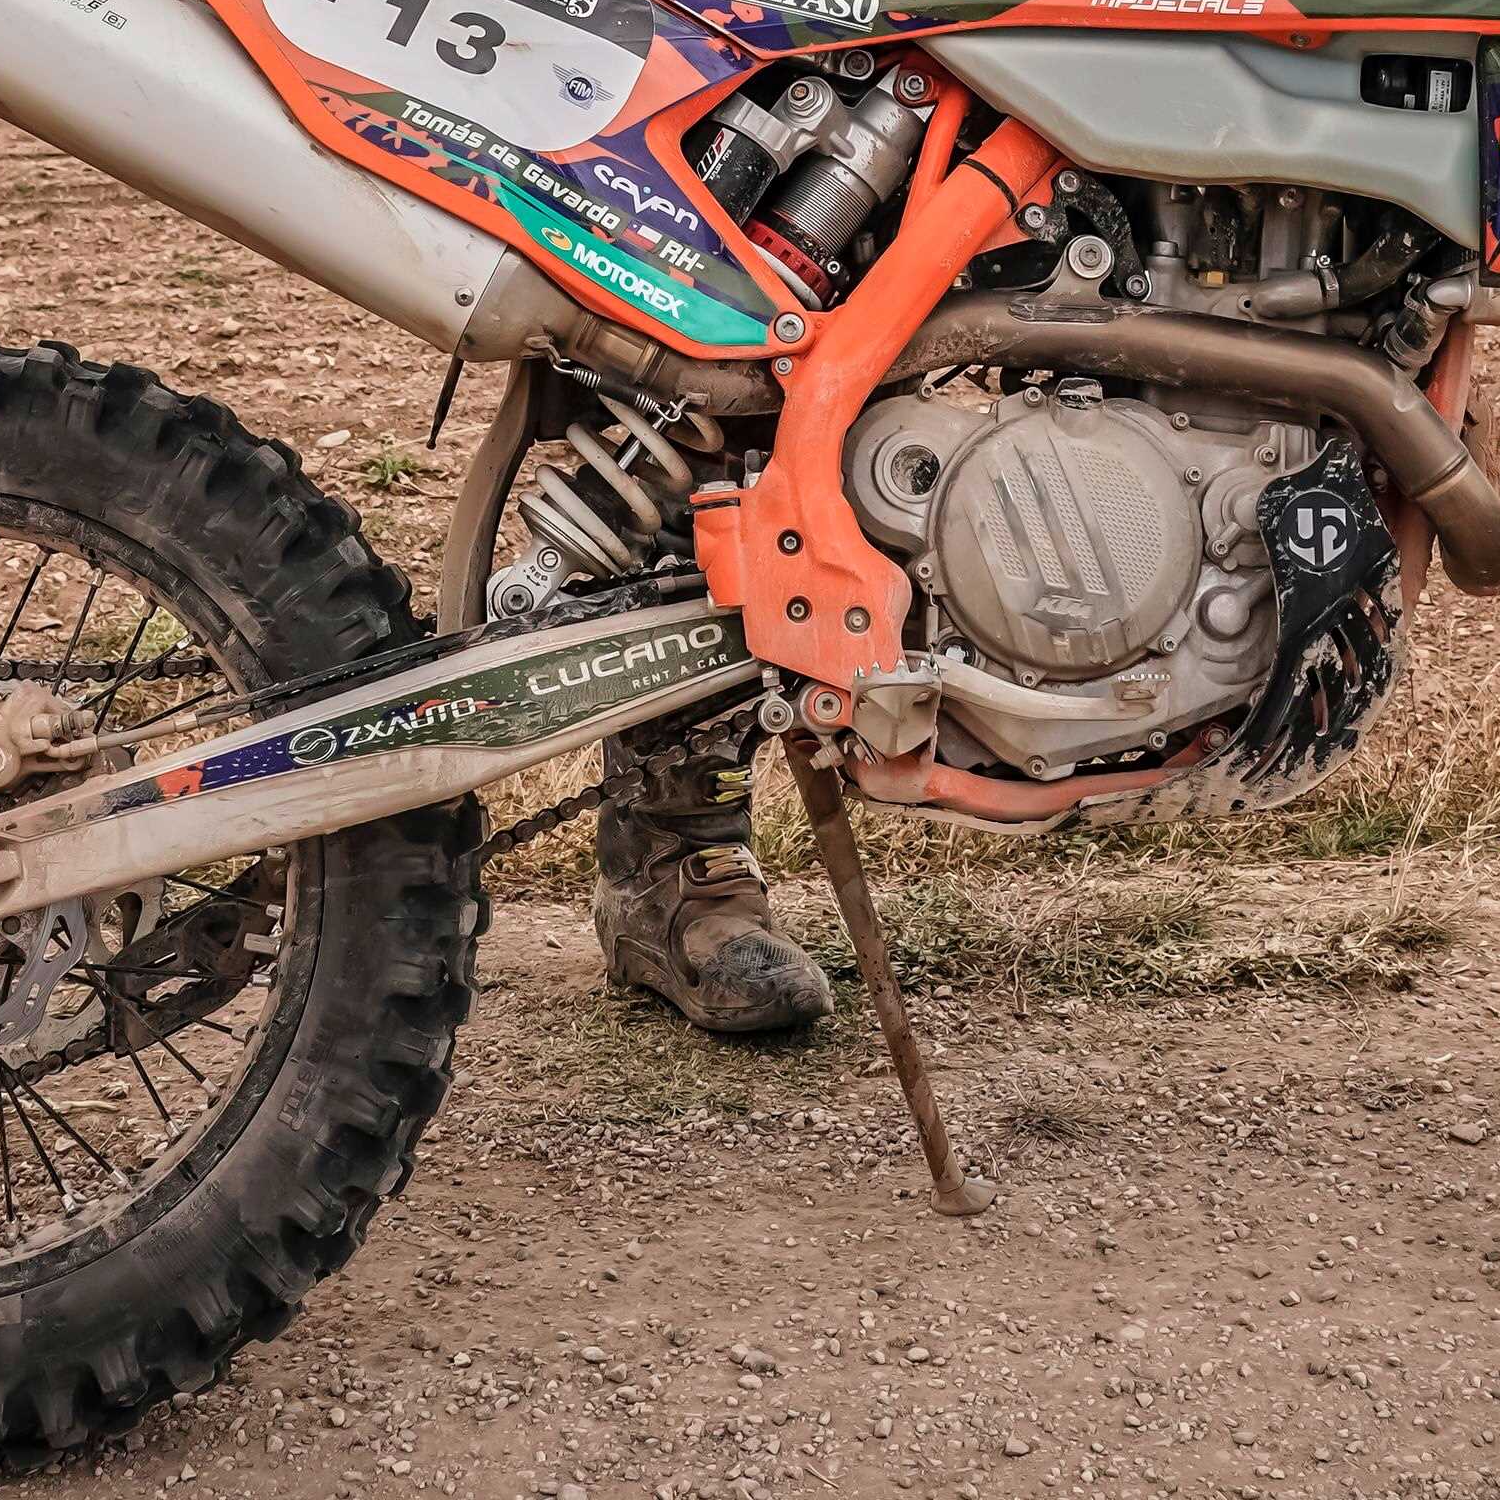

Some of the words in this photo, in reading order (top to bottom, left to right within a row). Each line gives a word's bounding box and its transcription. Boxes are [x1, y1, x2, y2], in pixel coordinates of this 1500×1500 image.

[568, 79, 593, 99] FIM
[400, 100, 487, 150] Tomás
[487, 139, 521, 170] de
[521, 163, 622, 231] Gavardo
[572, 242, 687, 320] MOTOREX
[526, 623, 724, 696] LUCANO
[632, 669, 672, 690] RENT
[680, 665, 690, 676] A
[697, 653, 729, 669] CAR
[341, 697, 477, 747] ZXAUTO
